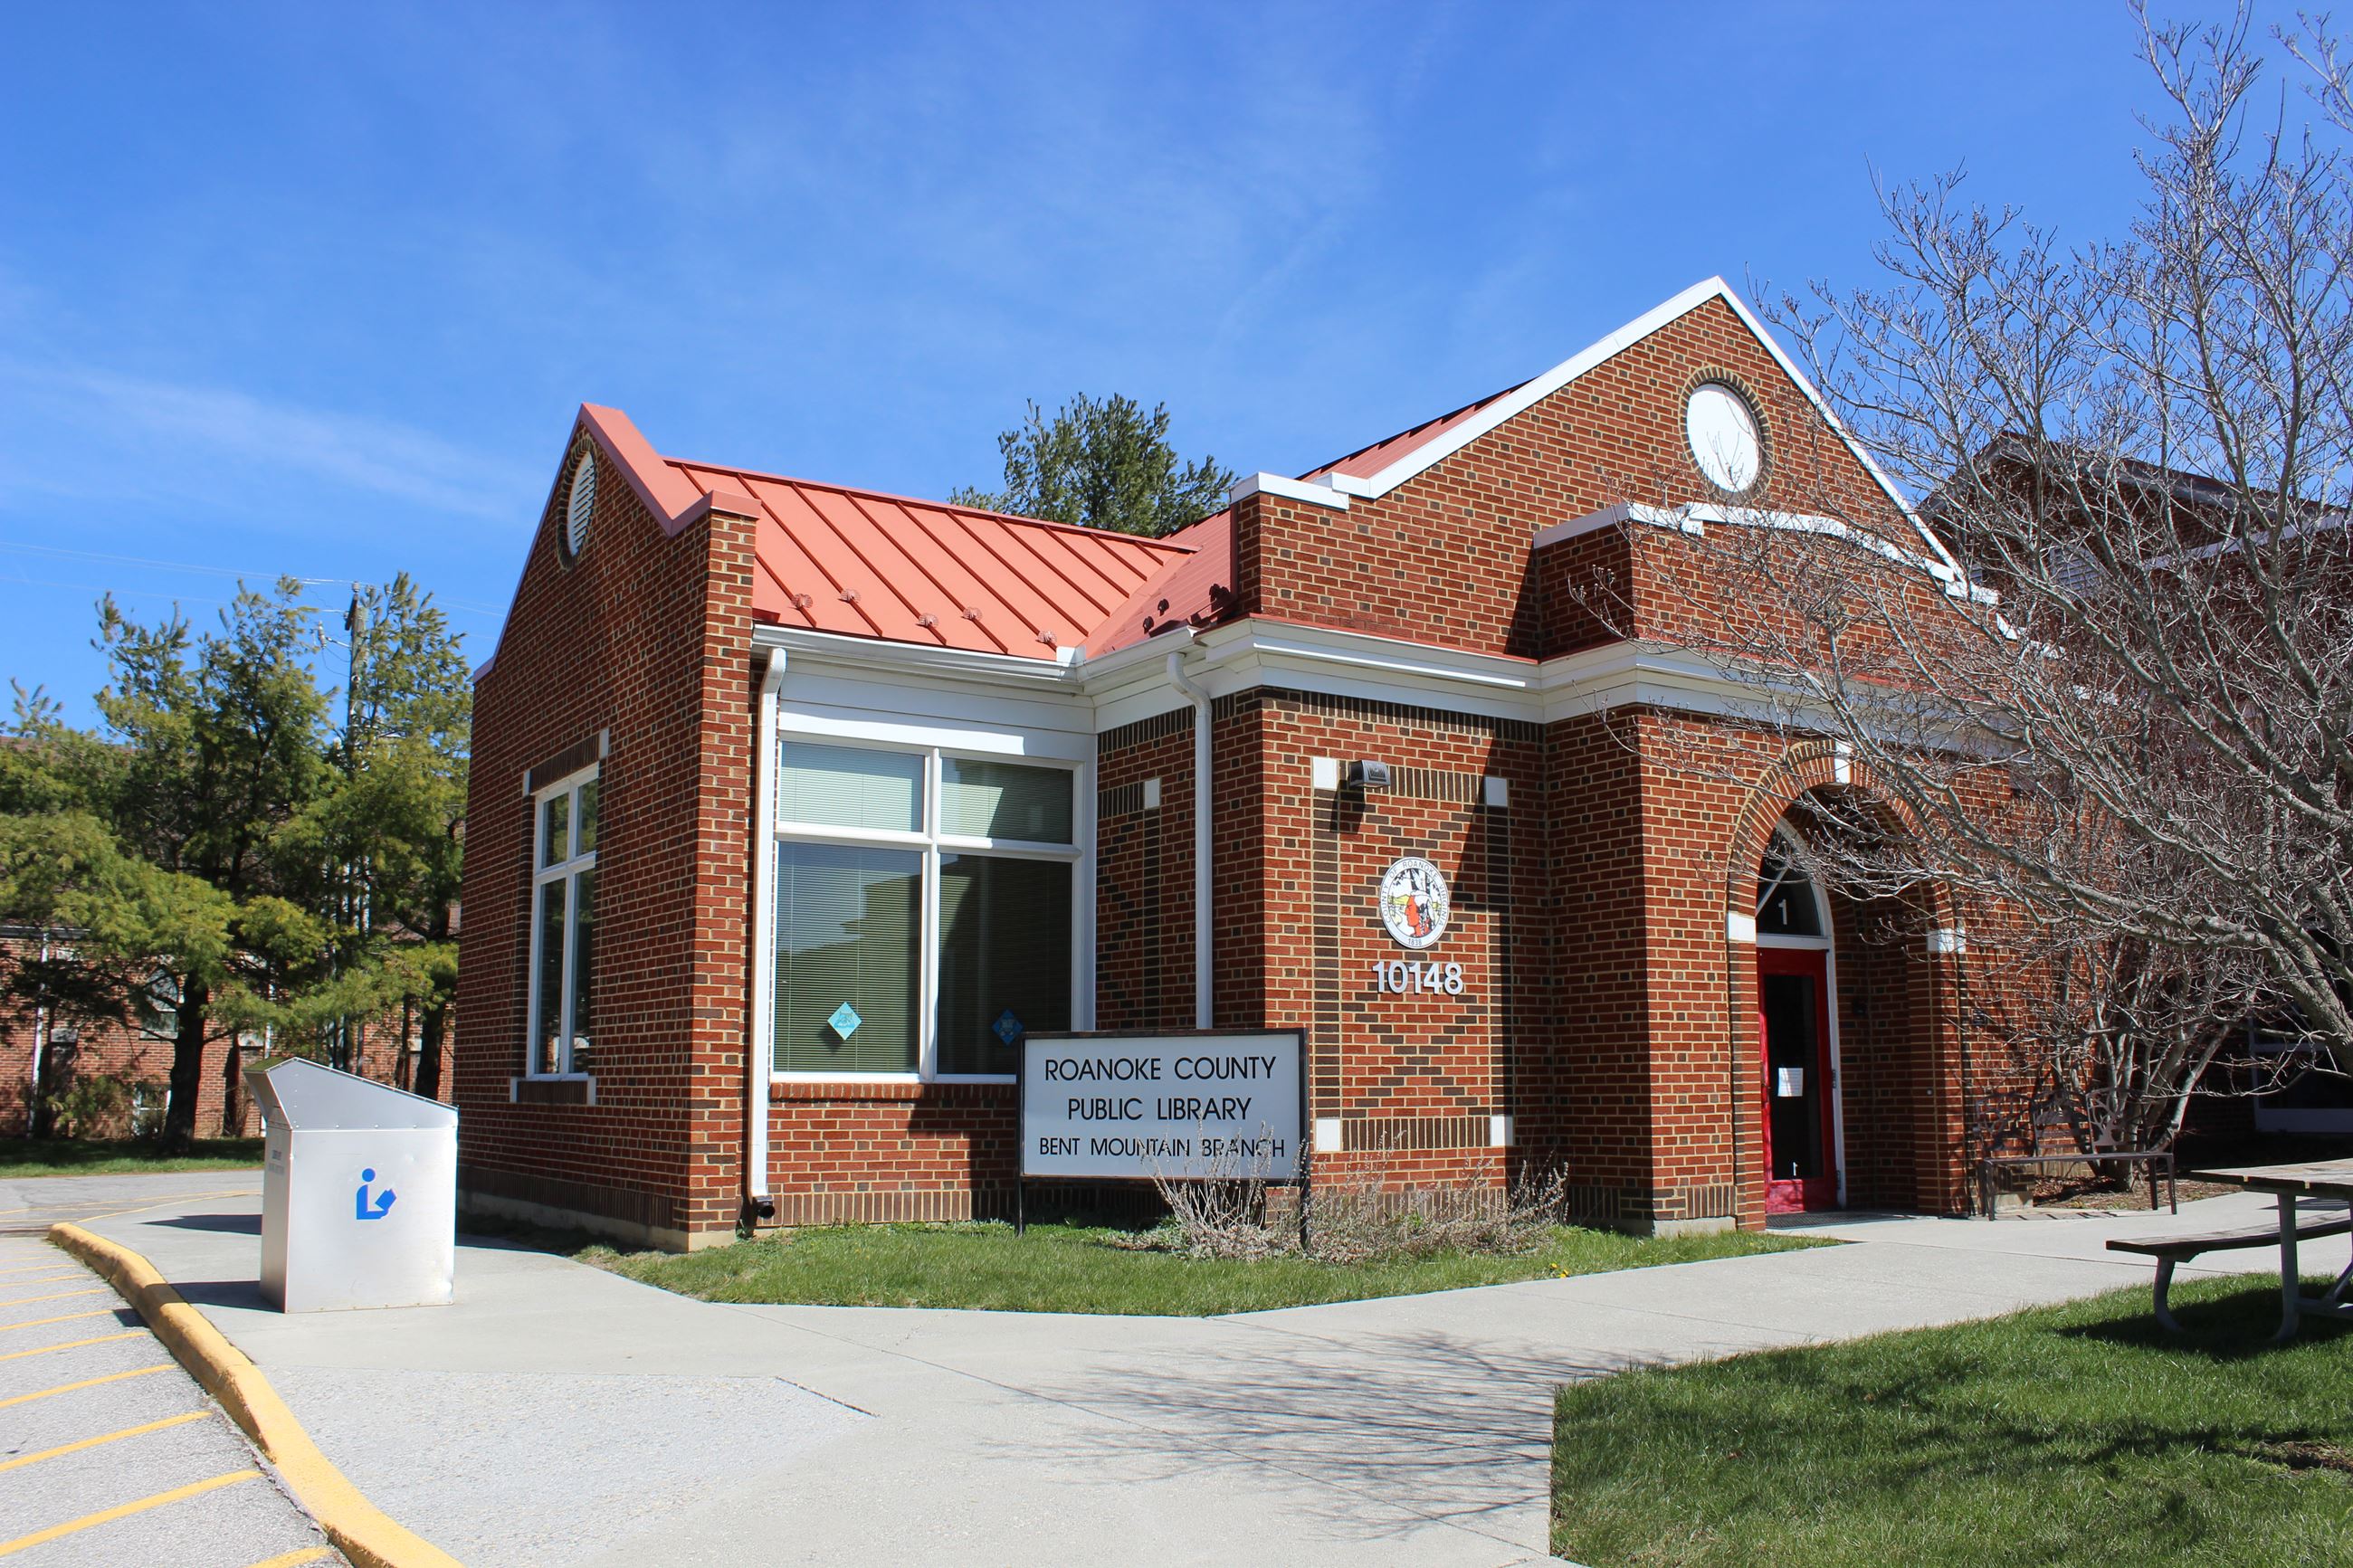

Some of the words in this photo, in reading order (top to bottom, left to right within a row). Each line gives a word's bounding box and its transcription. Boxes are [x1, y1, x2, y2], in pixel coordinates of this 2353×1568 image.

[1402, 860, 1437, 879] ROANOKE
[1778, 898, 1787, 925] 1
[1372, 961, 1463, 994] 10148
[1044, 1058, 1161, 1081] ROANOKE
[1174, 1056, 1277, 1079] COUNTY
[1068, 1098, 1143, 1120] PUBLIC
[1157, 1098, 1252, 1120] LIBRARY
[1040, 1137, 1081, 1155] BENT
[1091, 1137, 1190, 1156] MOUNTAIN
